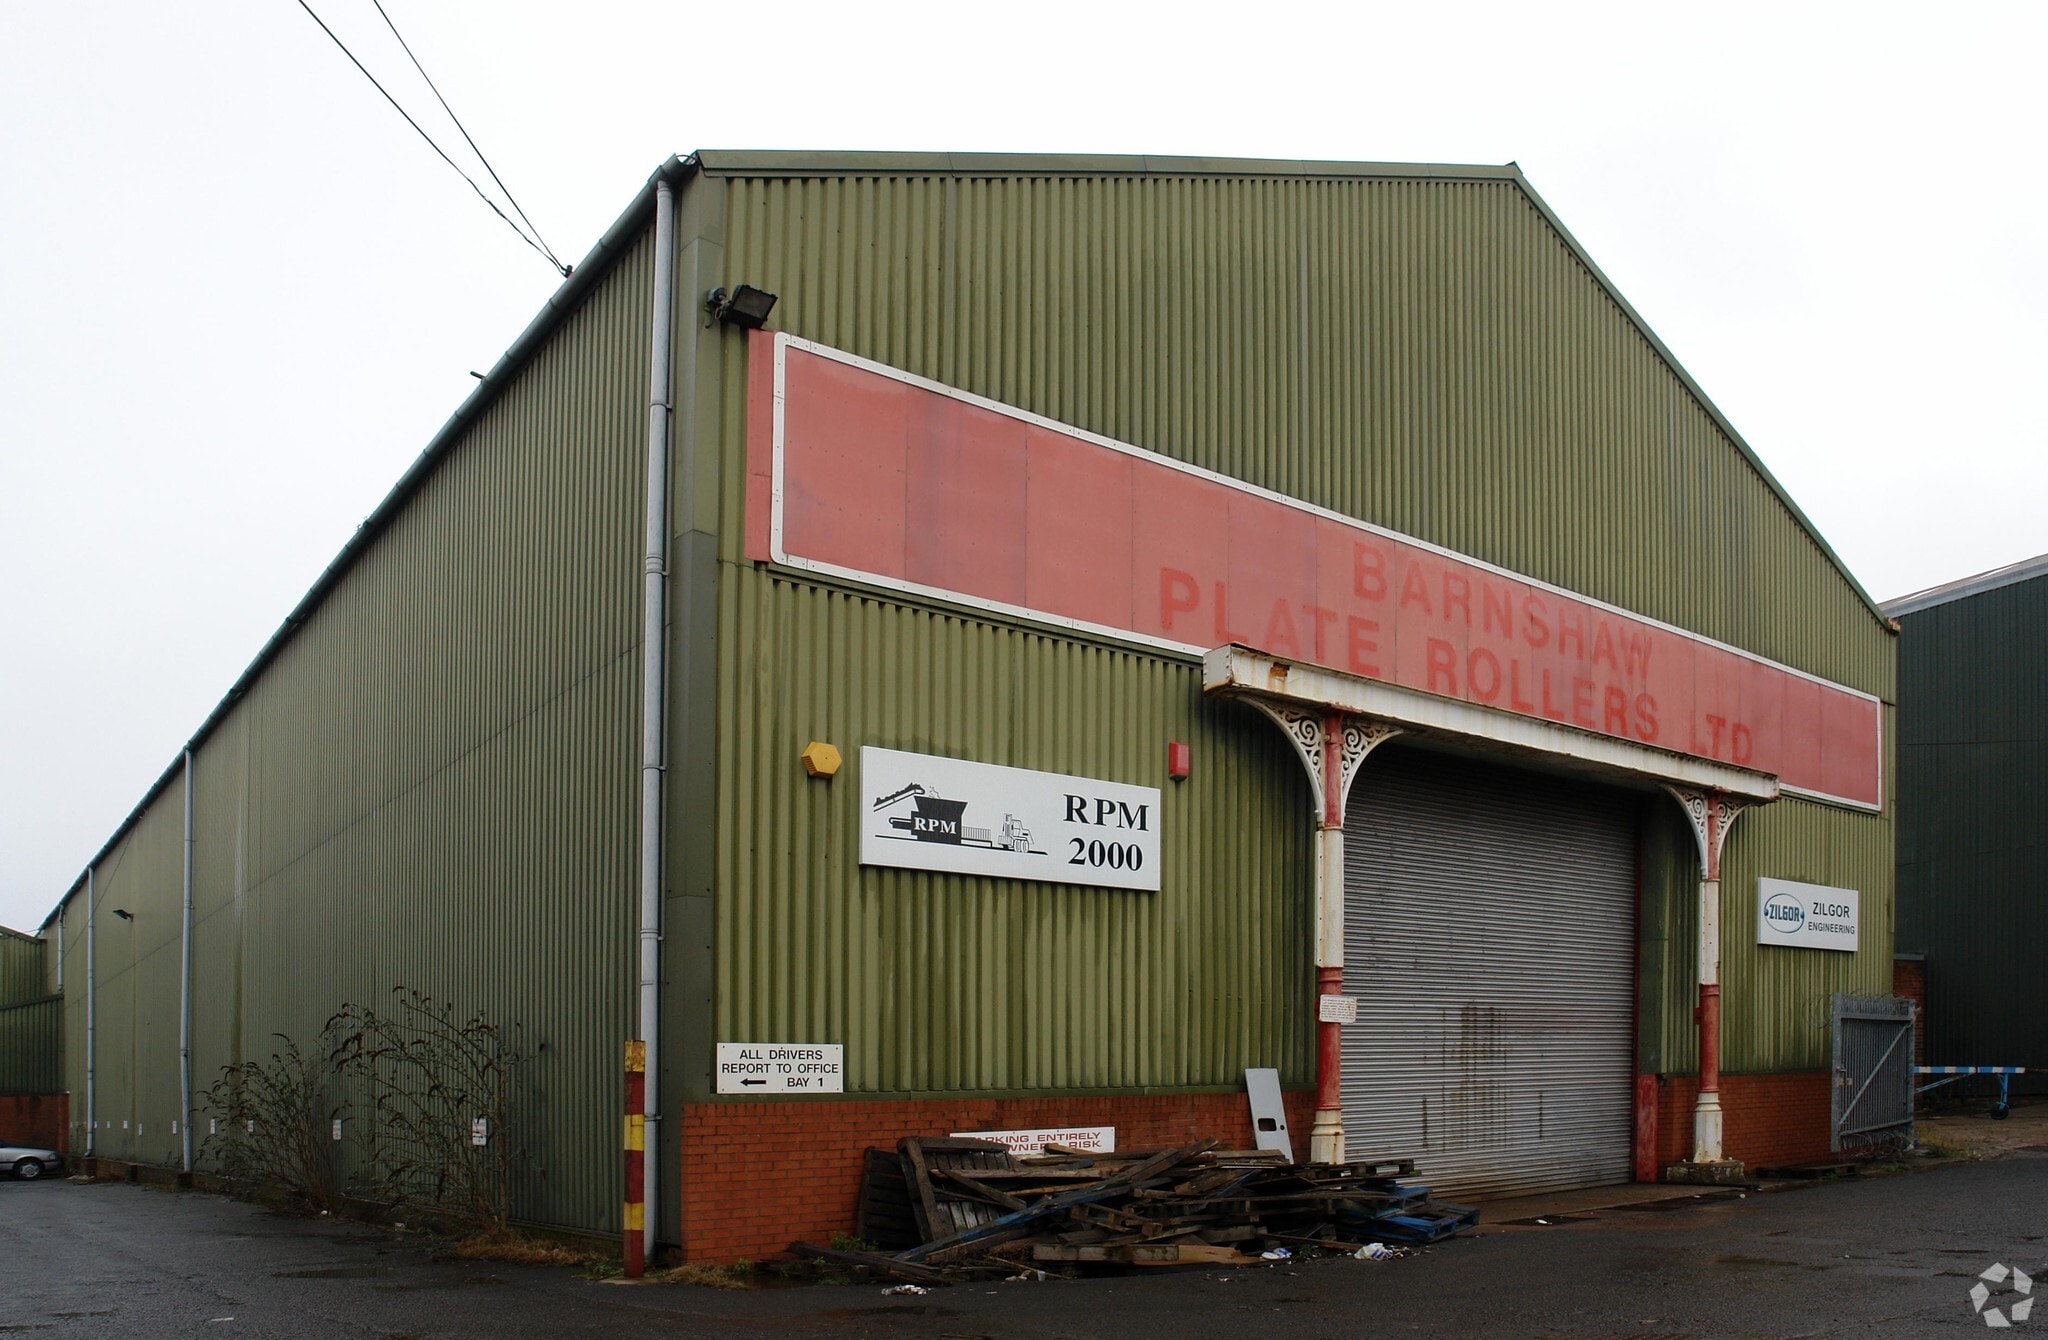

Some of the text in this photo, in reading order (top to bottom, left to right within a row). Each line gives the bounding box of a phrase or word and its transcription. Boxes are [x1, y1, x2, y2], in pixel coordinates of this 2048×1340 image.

[1352, 539, 1653, 680] BARNSHAW
[1159, 566, 1754, 766] PLATE ROLLERS LTD
[1063, 793, 1150, 831] RPM
[913, 816, 957, 835] RPM
[1068, 837, 1143, 872] 2000
[1769, 903, 1801, 922] ZILGOR
[1812, 902, 1850, 919] ZILGOR
[1807, 921, 1855, 935] ENGINEERING
[739, 1049, 823, 1060] ALL DRIVERS
[721, 1063, 839, 1074] REPORT TO OFFICE
[787, 1077, 824, 1087] BAY 1
[1037, 1131, 1101, 1142] ENTIRELY
[1069, 1140, 1101, 1149] RISK
